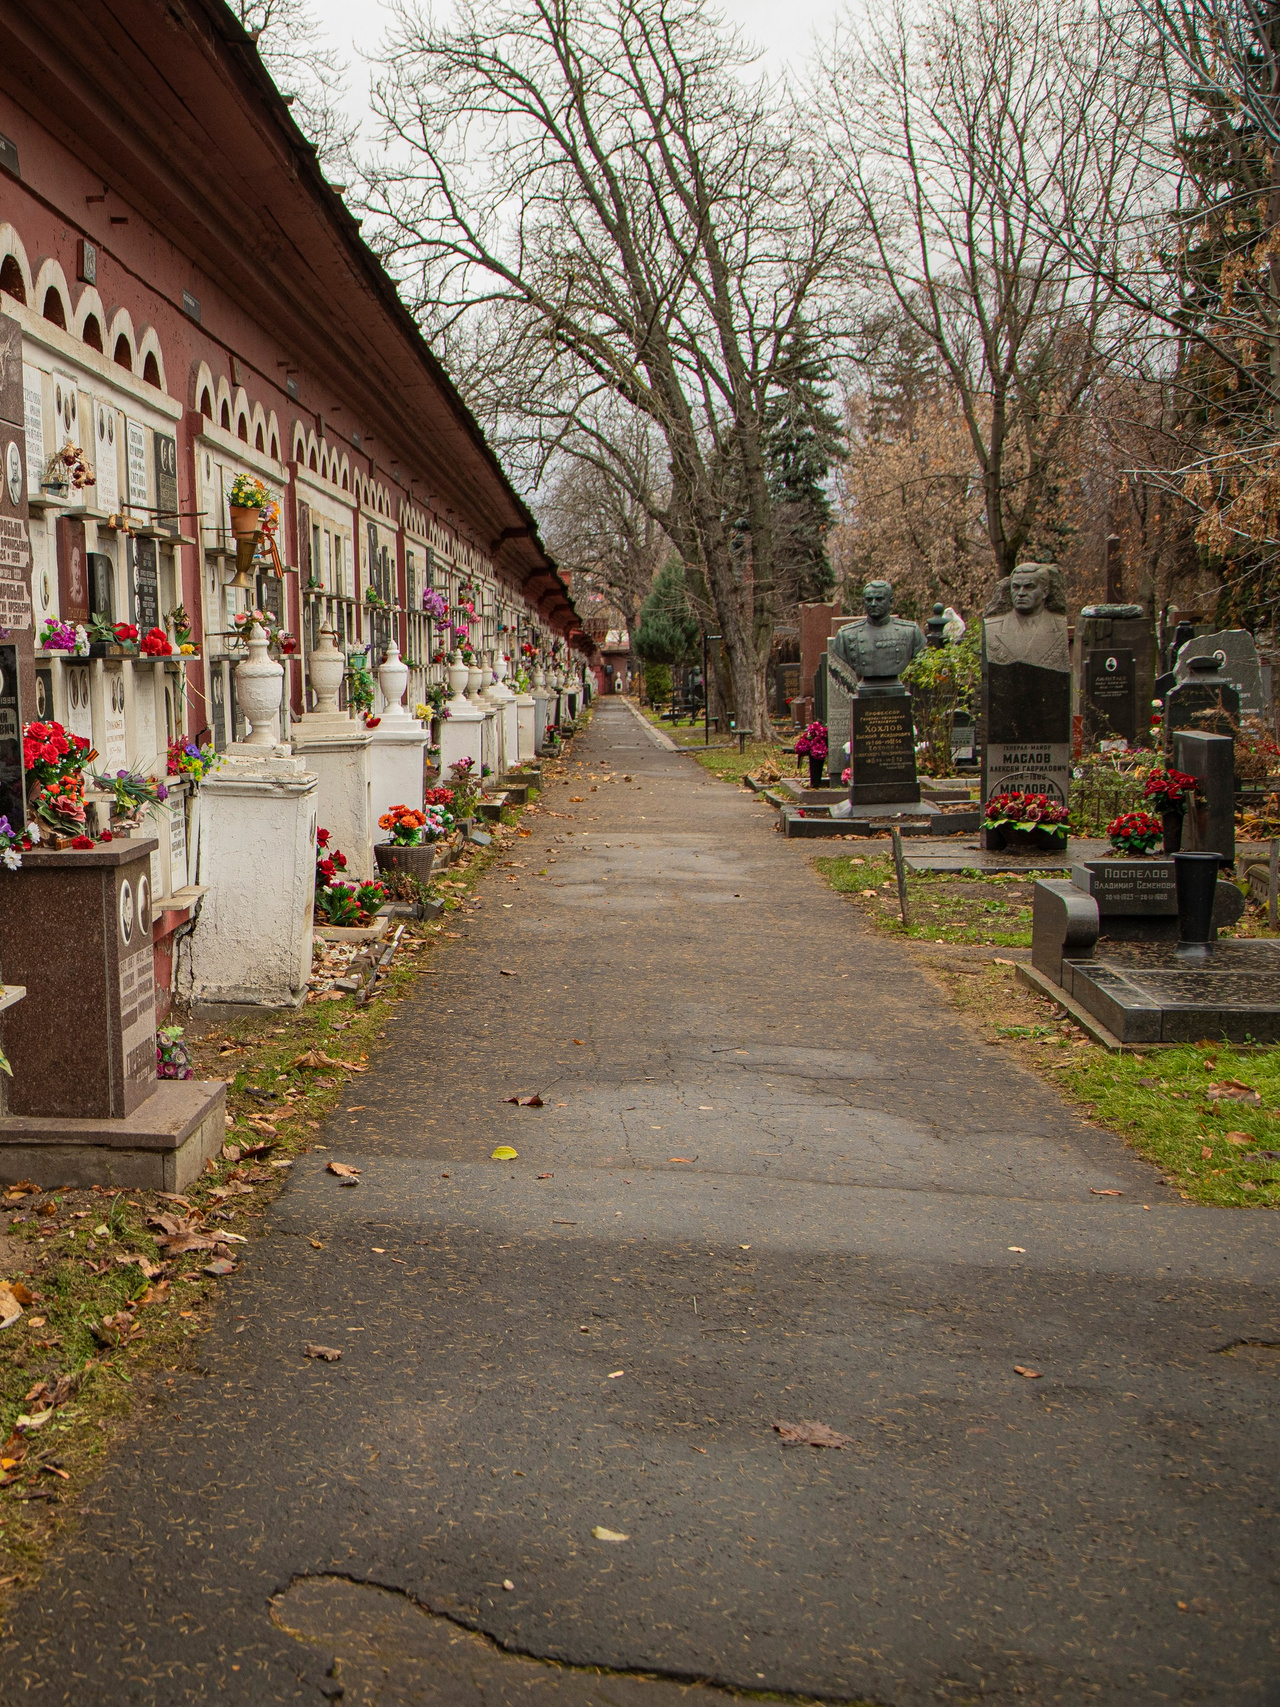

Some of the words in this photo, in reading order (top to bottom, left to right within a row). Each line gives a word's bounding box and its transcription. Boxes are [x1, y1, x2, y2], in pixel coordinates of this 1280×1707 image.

[865, 724, 903, 733] ХОХЛОВ
[1003, 753, 1051, 764] МАСЛОВ
[1000, 783, 1054, 794] МАСЛОВА
[1136, 880, 1176, 889] СЕМЕНОВИ
